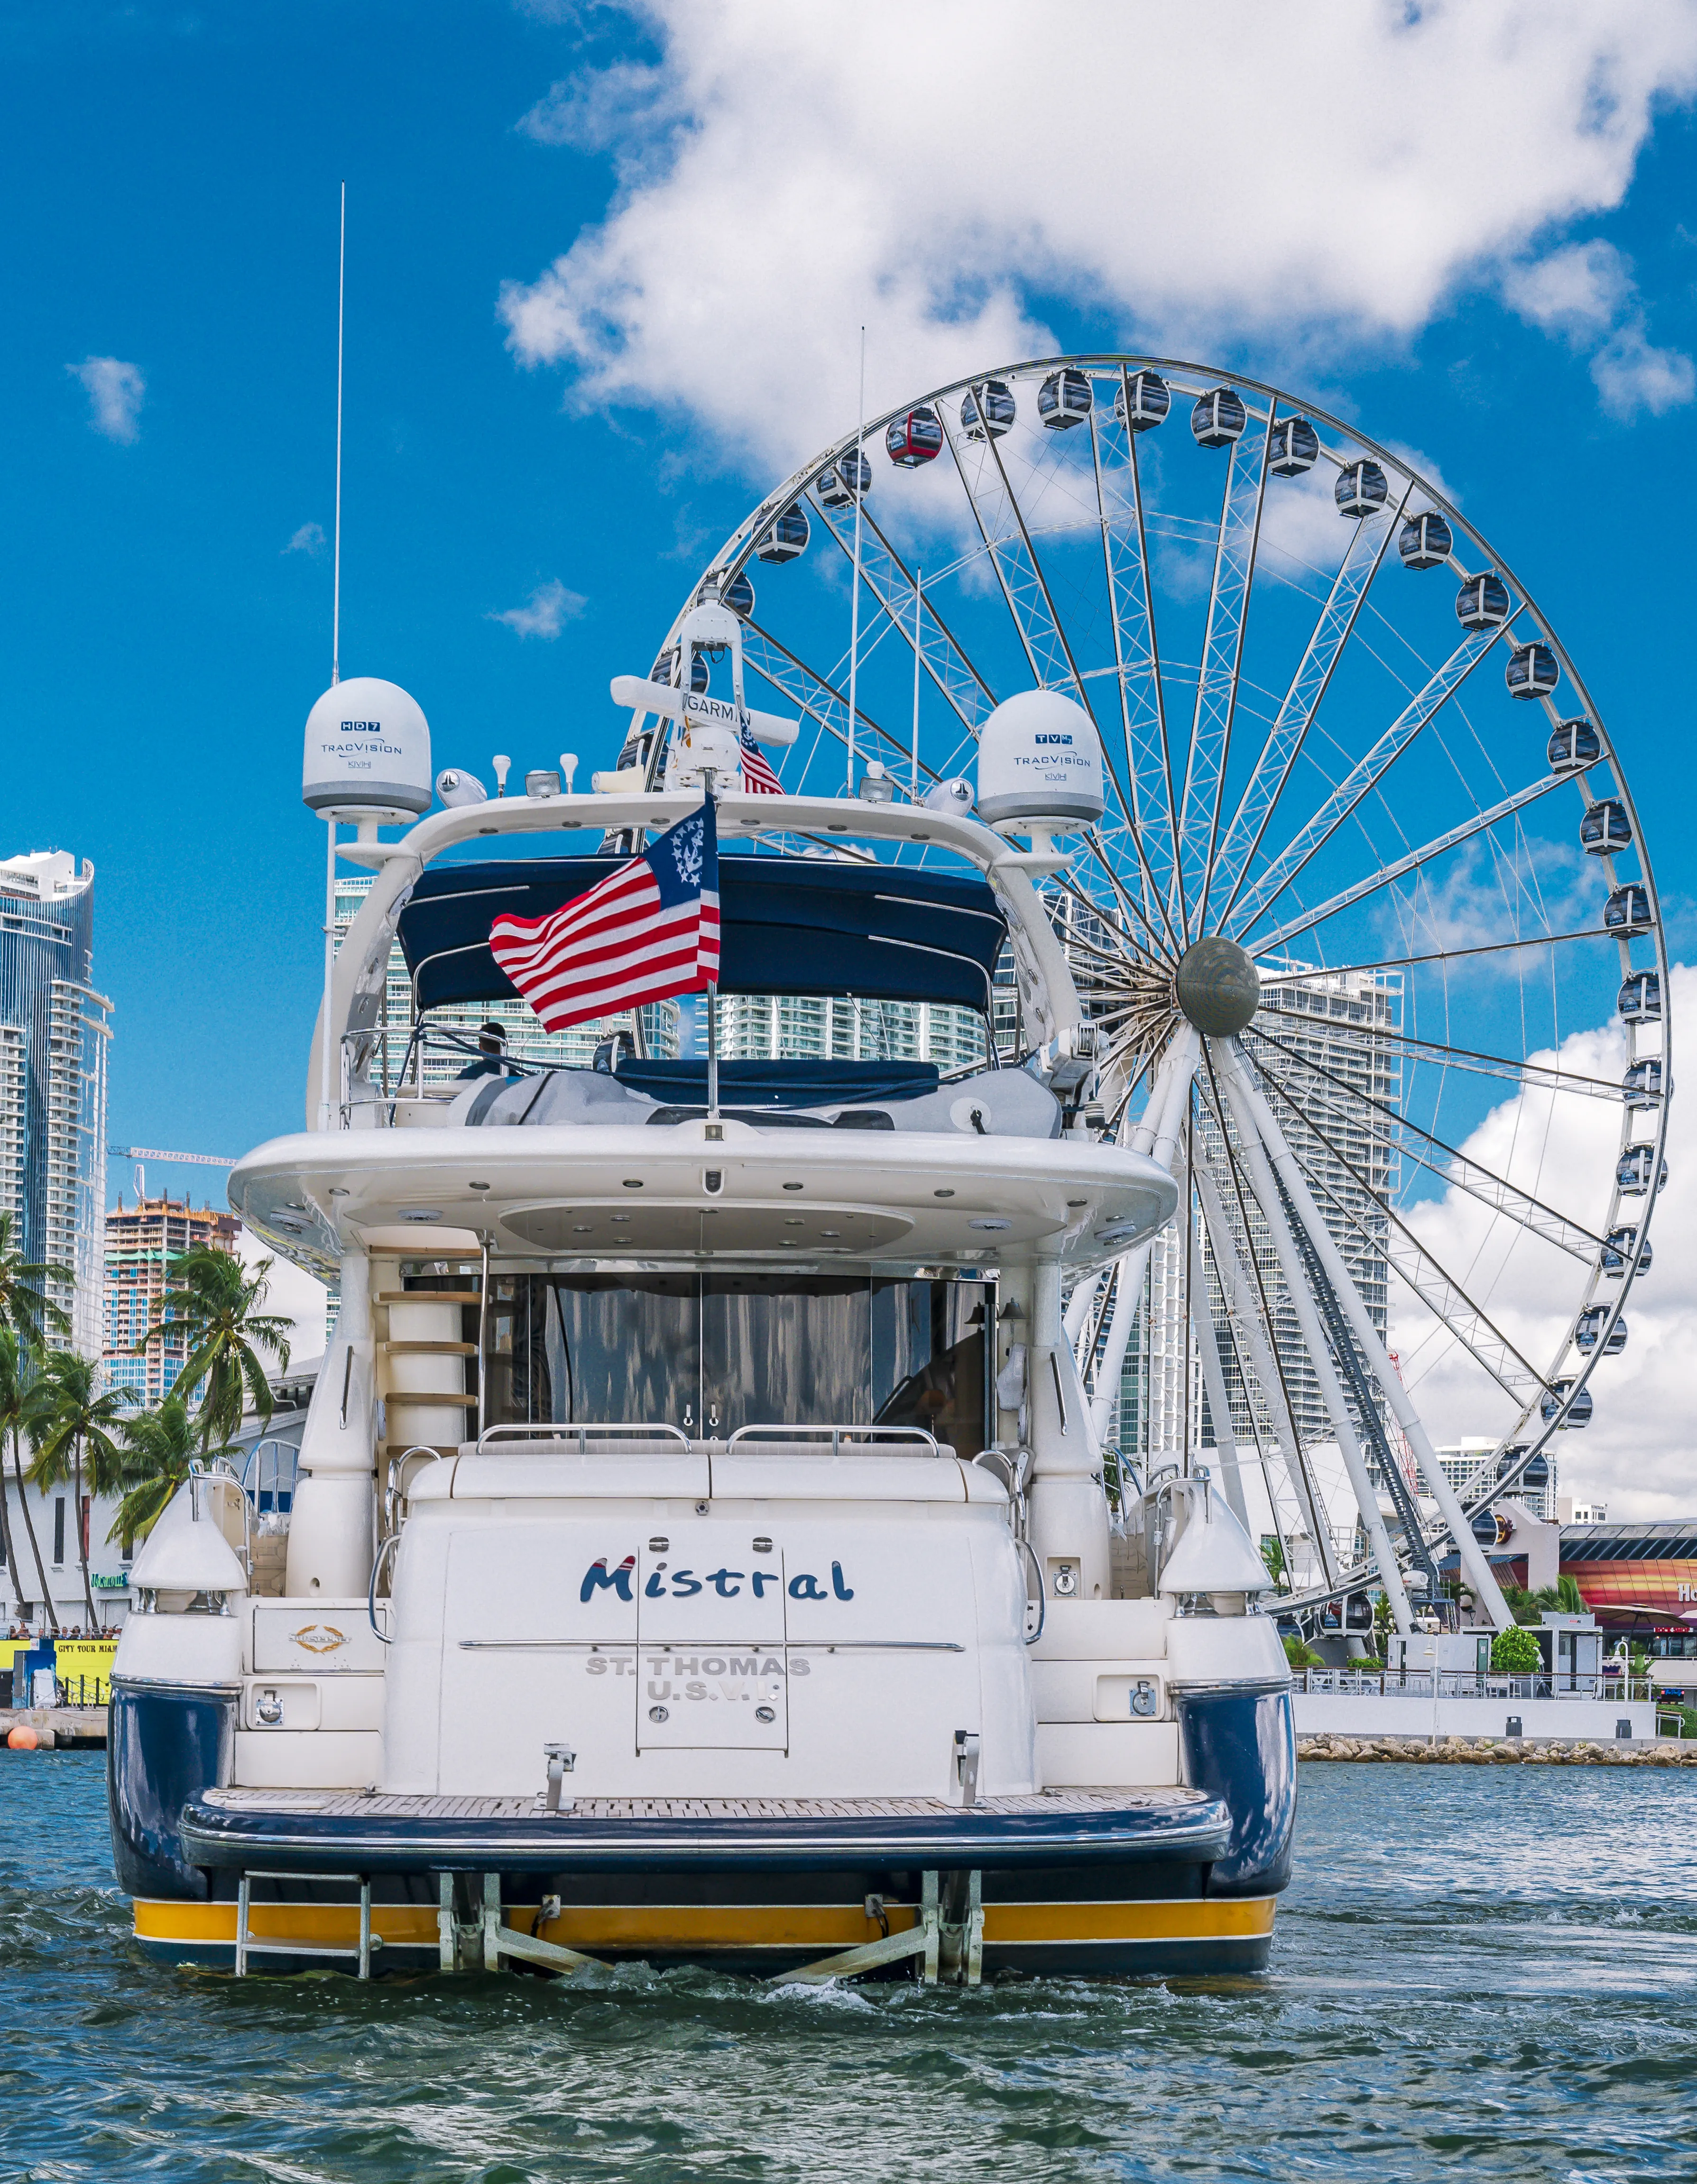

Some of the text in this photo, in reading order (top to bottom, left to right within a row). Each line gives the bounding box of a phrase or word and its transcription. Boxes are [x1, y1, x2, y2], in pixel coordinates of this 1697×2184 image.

[688, 696, 751, 726] GARMN
[341, 722, 380, 731] HD7
[348, 761, 371, 769] KVH
[1045, 773, 1067, 781] KVH
[580, 1556, 854, 1602] Mistral
[585, 1657, 811, 1676] ST. THOMAS
[648, 1681, 779, 1701] U.S.V.I.
